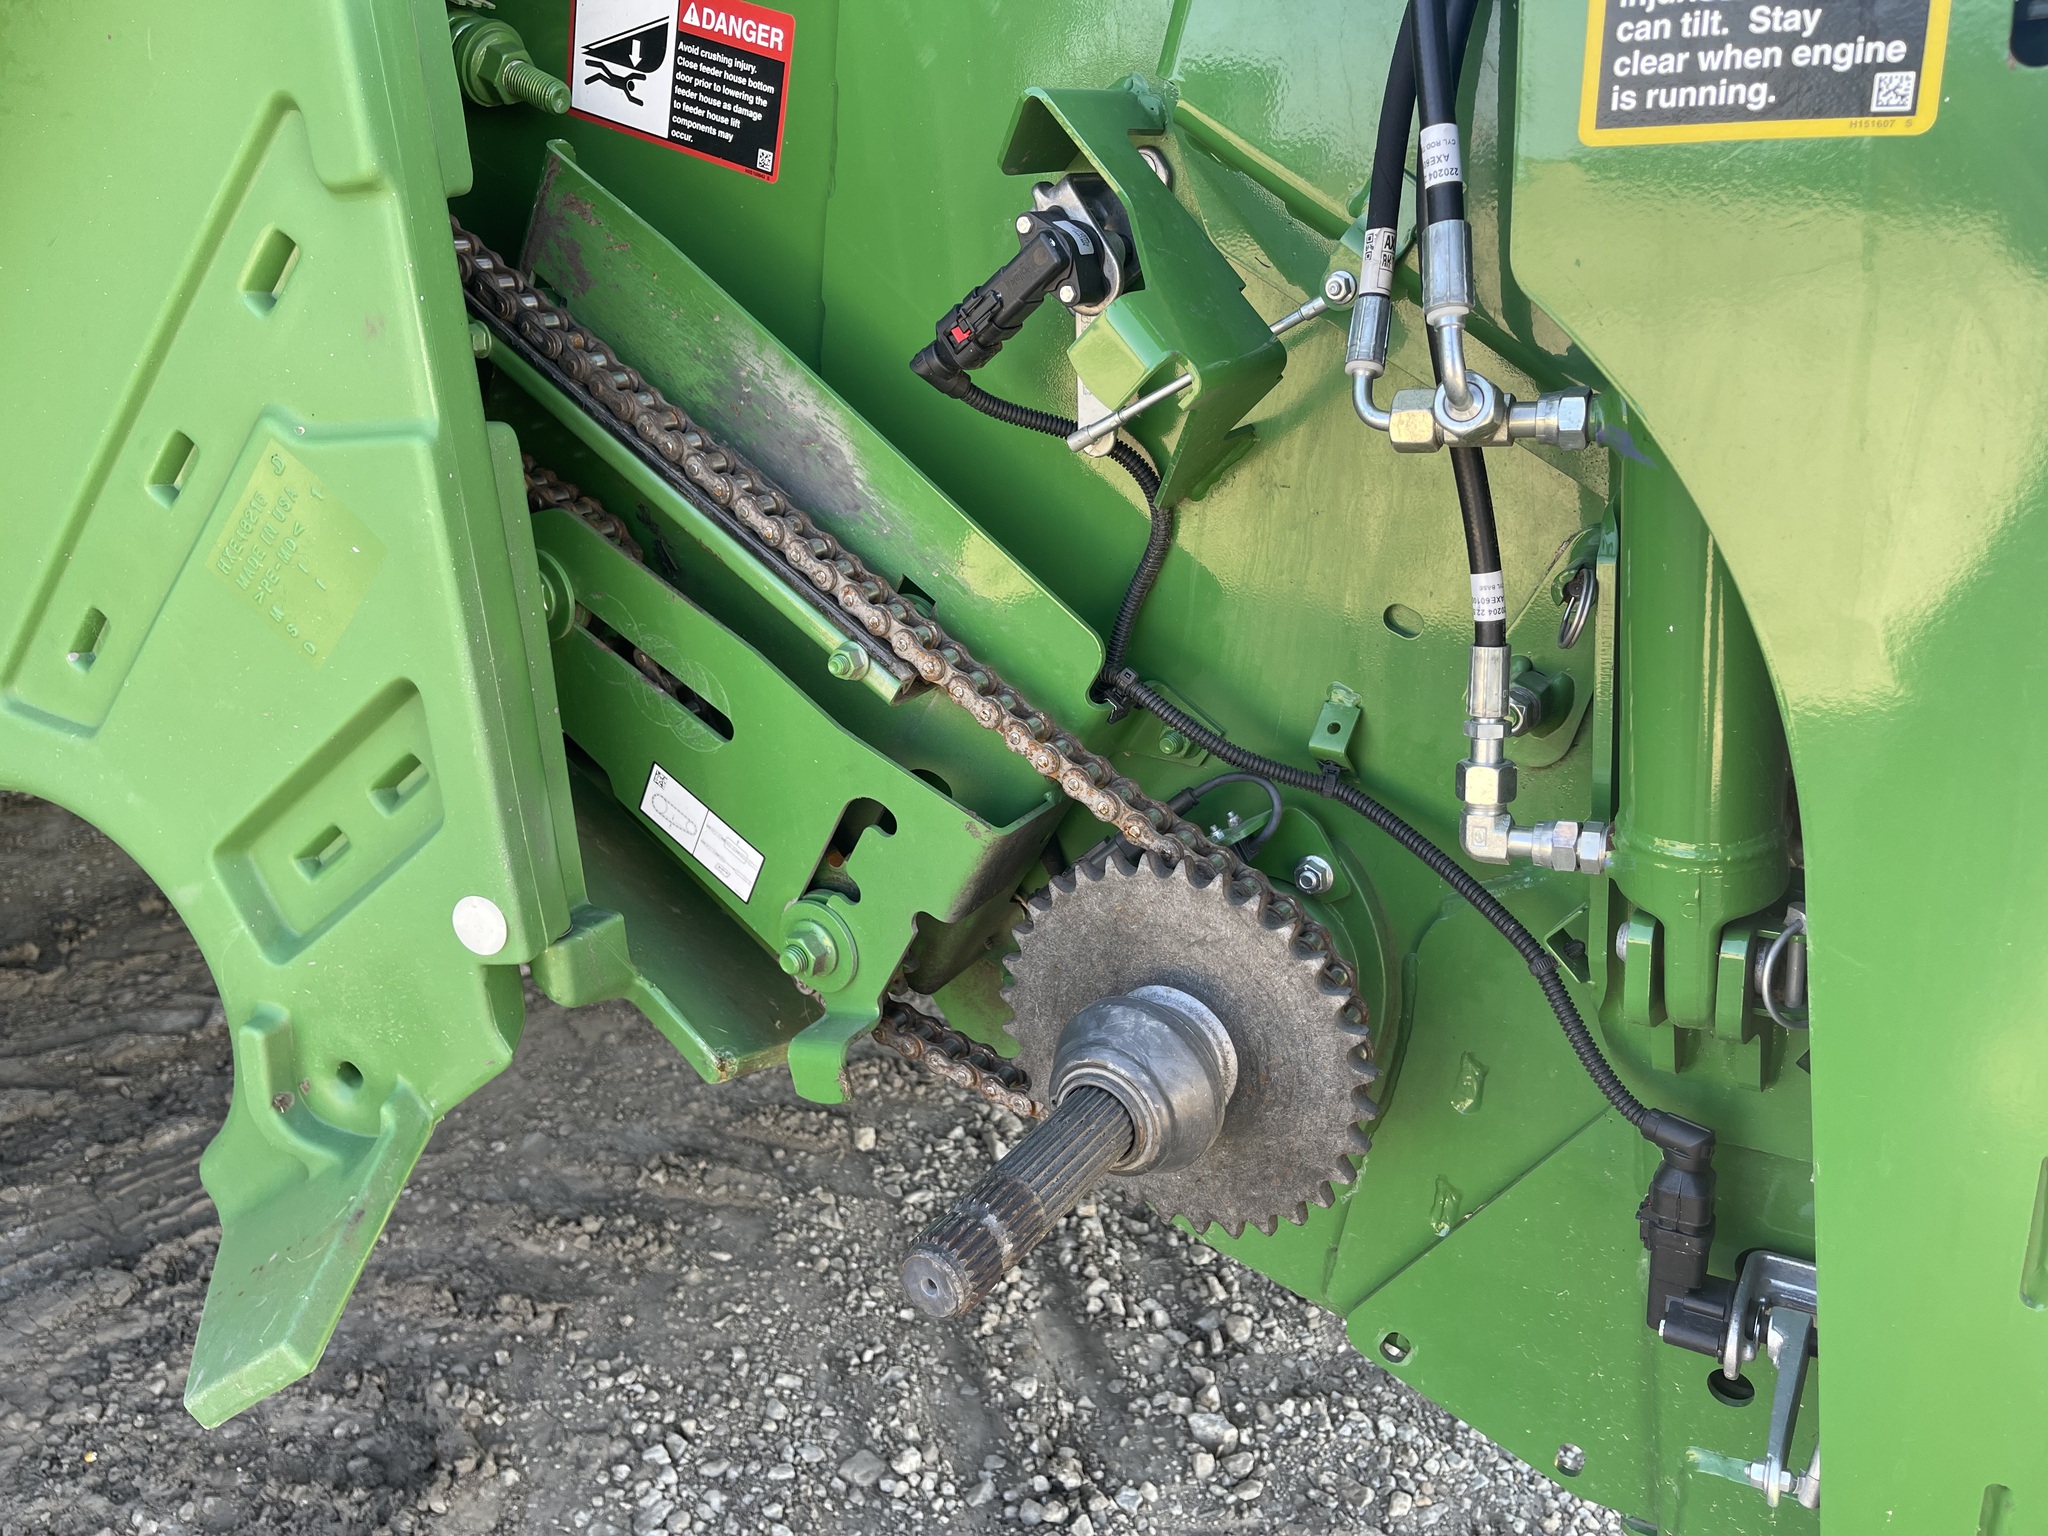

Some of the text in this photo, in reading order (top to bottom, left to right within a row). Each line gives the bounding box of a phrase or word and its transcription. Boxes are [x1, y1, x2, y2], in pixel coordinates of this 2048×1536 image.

[702, 7, 784, 51] DANGER
[1616, 18, 1671, 42] can
[1680, 9, 1729, 38] tilt.
[1748, 4, 1823, 38] Stay
[678, 41, 757, 75] Avoid crushing injury.
[1613, 35, 1908, 77] clear when engine
[676, 71, 768, 107] door prior to lowering the
[677, 56, 775, 94] Close feeder house bottom
[674, 85, 763, 122] feeder house as damage
[1610, 78, 1776, 111] is running.
[672, 115, 734, 143] components may
[673, 100, 741, 129] to feeder house lift
[1849, 119, 1896, 128] H151607
[671, 129, 693, 143] occur.
[236, 486, 299, 590] MADE IN USA
